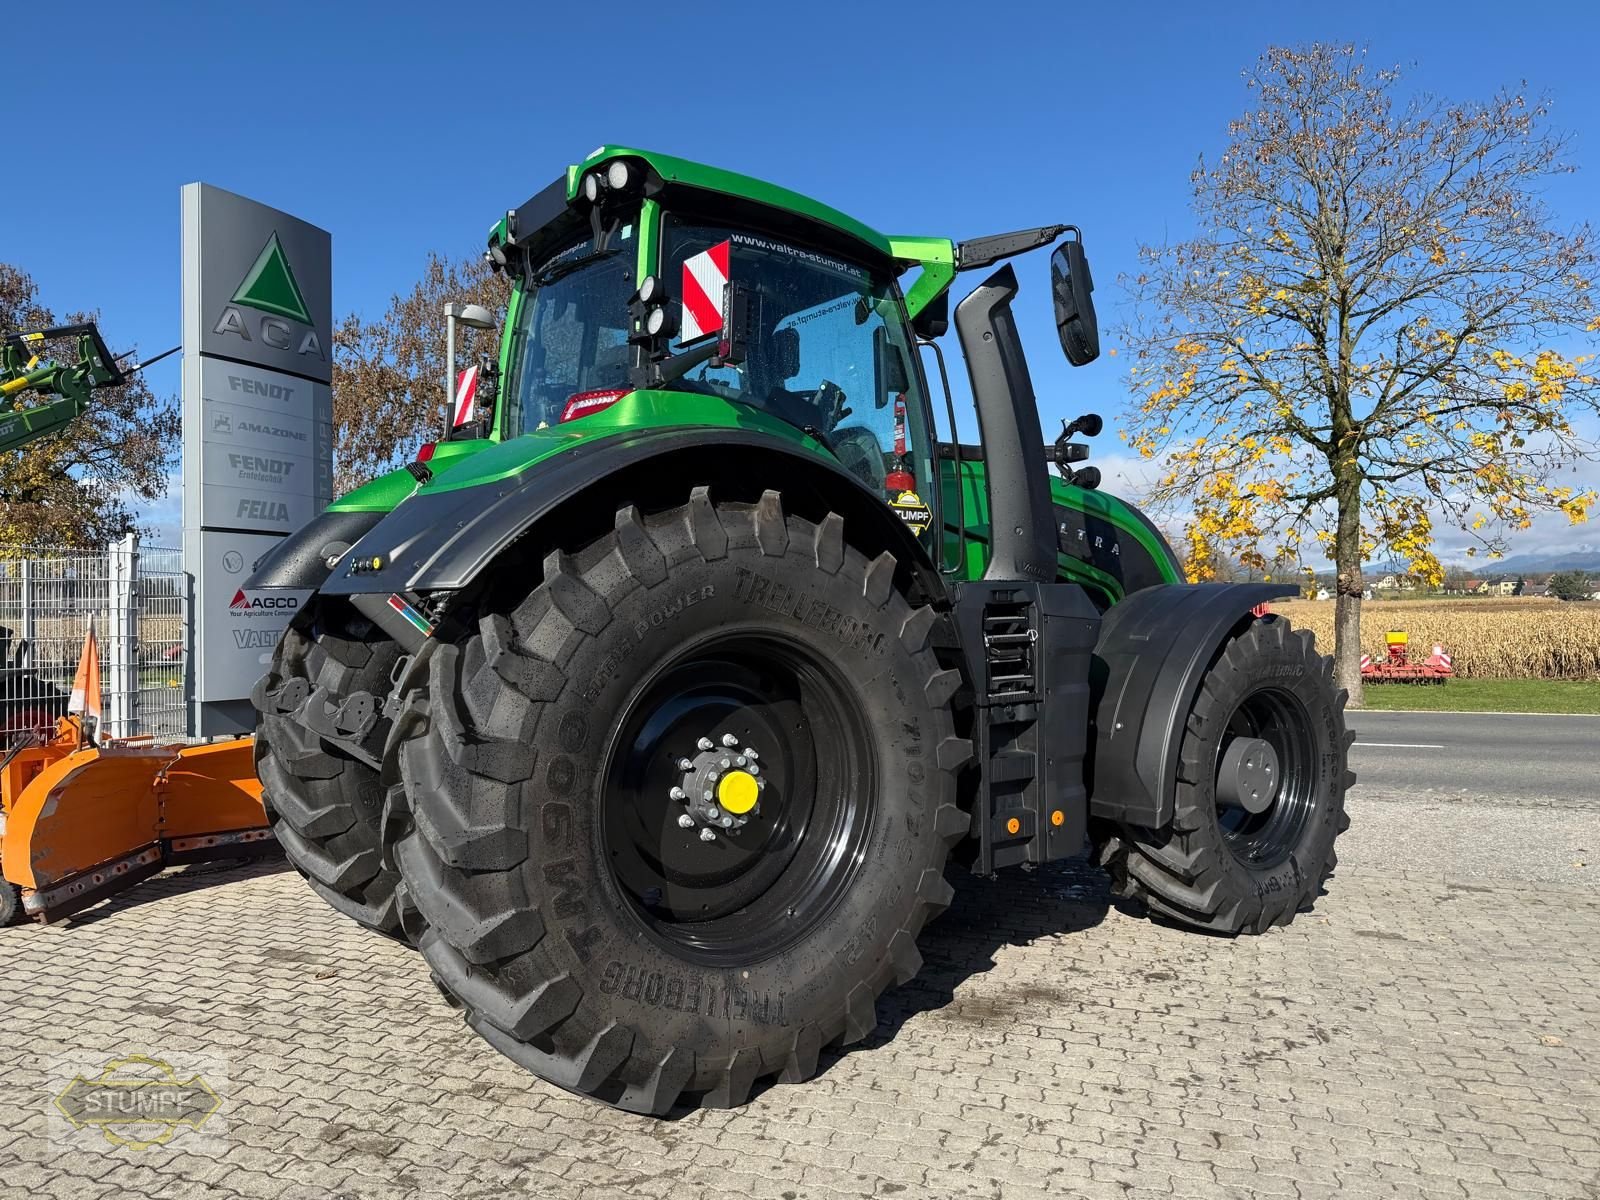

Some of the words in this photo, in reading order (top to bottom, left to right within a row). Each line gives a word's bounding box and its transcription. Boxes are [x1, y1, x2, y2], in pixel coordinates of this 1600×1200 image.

[731, 233, 862, 277] www.valtra-stumpf.at
[212, 306, 327, 362] ACA
[228, 375, 295, 402] FENDT
[237, 422, 308, 442] AMAZONE
[228, 453, 295, 476] FENDT
[238, 469, 284, 484] Erntetechnik
[236, 499, 290, 522] FELLA
[243, 610, 274, 618] Agriculture
[251, 597, 298, 609] AGCO
[633, 583, 716, 642] POWER
